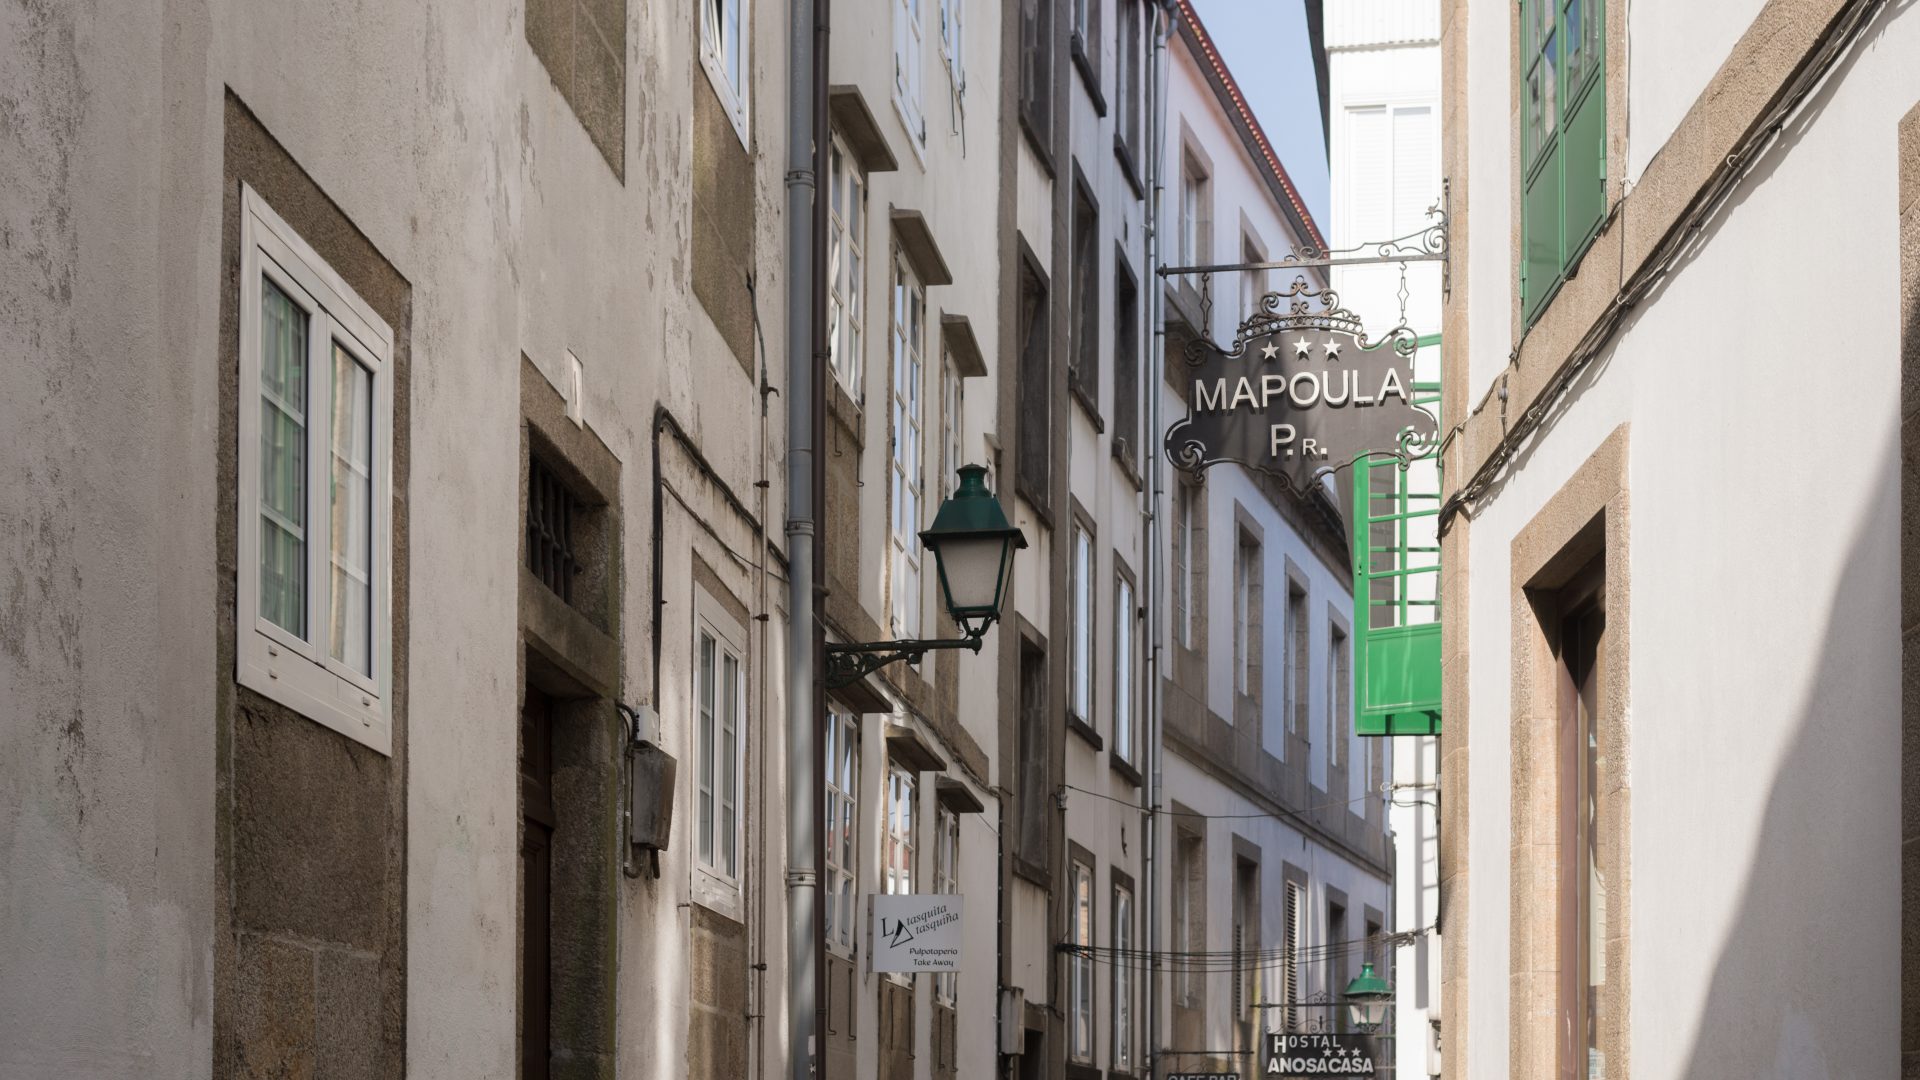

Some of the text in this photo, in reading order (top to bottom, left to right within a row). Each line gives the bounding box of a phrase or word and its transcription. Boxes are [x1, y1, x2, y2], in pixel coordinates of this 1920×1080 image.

[1195, 368, 1407, 411] MAPOULA
[906, 904, 947, 926] tasquita
[915, 912, 959, 935] tasquiña
[932, 959, 954, 967] Away
[1274, 1035, 1341, 1054] HOSTAL
